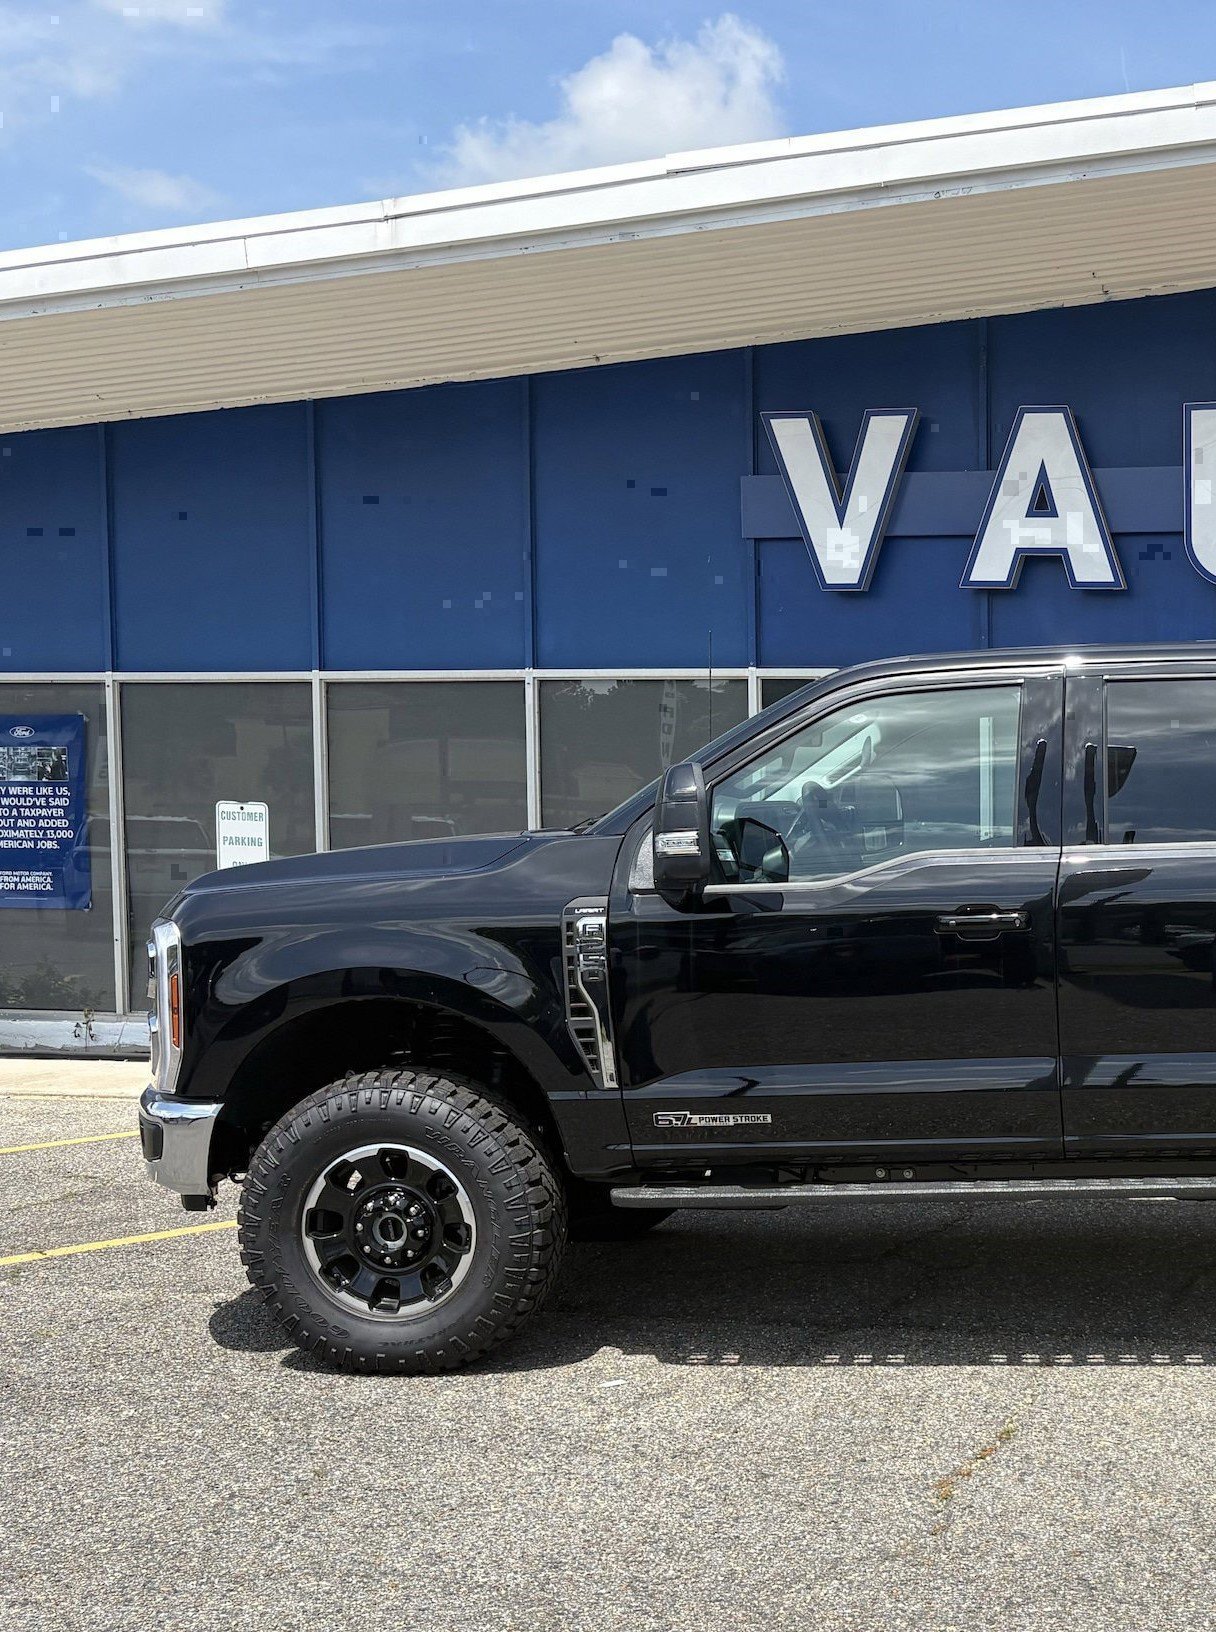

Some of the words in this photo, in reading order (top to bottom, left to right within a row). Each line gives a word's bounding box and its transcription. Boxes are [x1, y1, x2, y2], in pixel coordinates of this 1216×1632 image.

[12, 726, 32, 737] Ford
[8, 786, 34, 795] WERE
[35, 786, 54, 795] LIKE
[55, 786, 71, 796] US,
[1, 797, 47, 806] WOULD'VE
[48, 797, 70, 806] SAID
[11, 808, 18, 817] A
[19, 808, 65, 817] TAXPAYER
[220, 810, 264, 822] CUSTOMER
[16, 818, 37, 828] AND
[38, 818, 70, 828] ADDED
[45, 829, 74, 839] 13,000
[36, 840, 60, 849] JOBS.
[222, 835, 263, 847] PARKING
[16, 883, 54, 891] AMERICA.
[699, 1115, 731, 1123] POWER
[732, 1115, 769, 1123] STROKE
